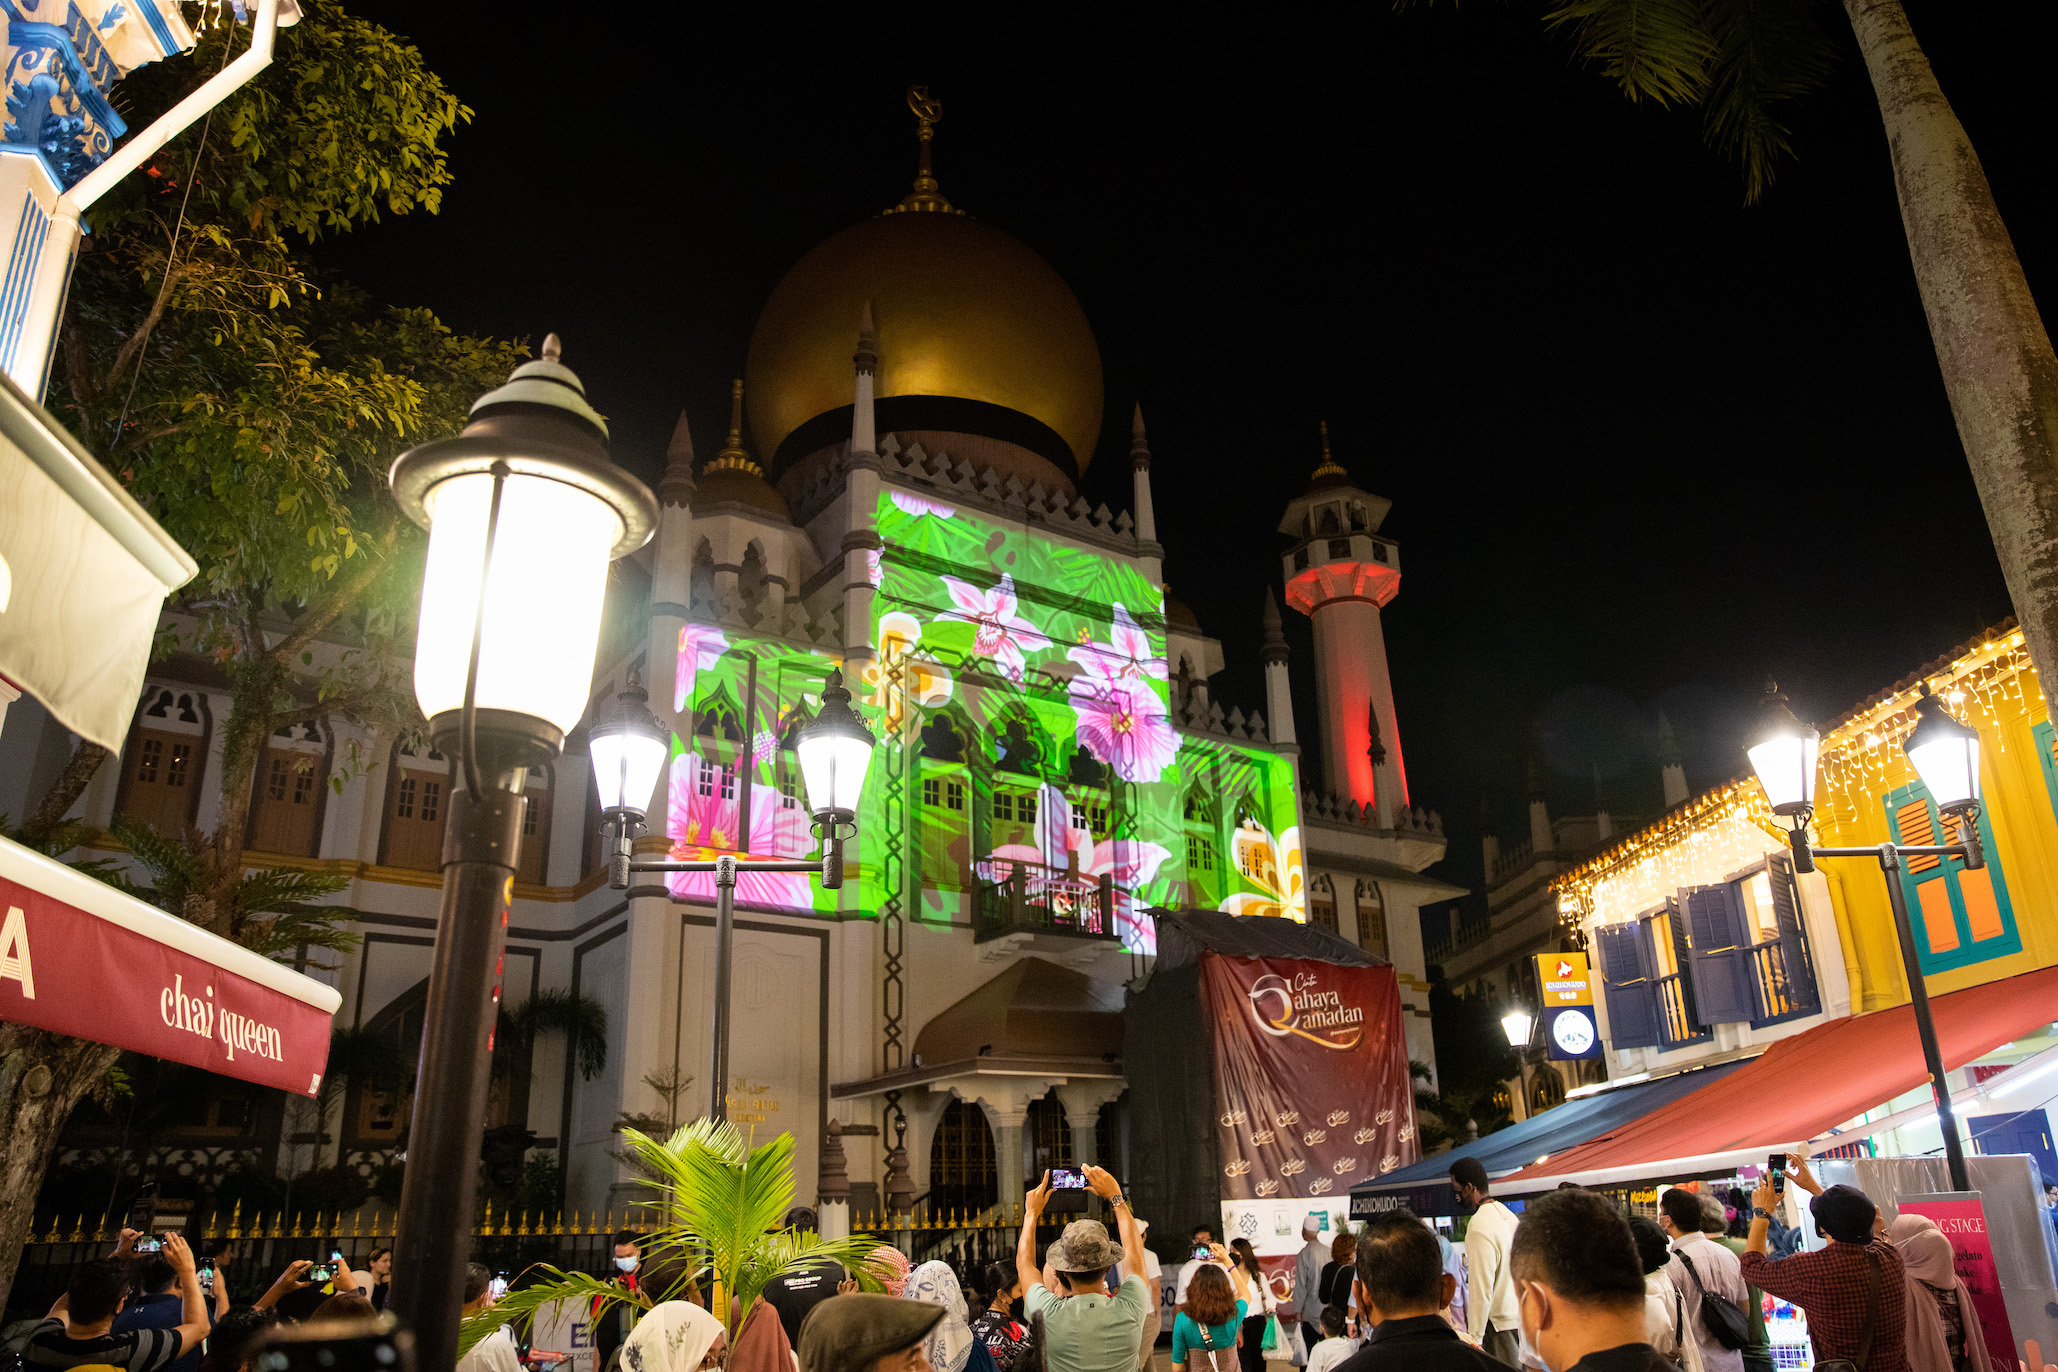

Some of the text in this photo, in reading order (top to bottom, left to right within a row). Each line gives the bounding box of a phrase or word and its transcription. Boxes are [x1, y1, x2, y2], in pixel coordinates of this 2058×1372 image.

[160, 973, 284, 1062] chai queen
[1950, 1217, 1985, 1233] STAGE
[1956, 1250, 1983, 1262] gelato
